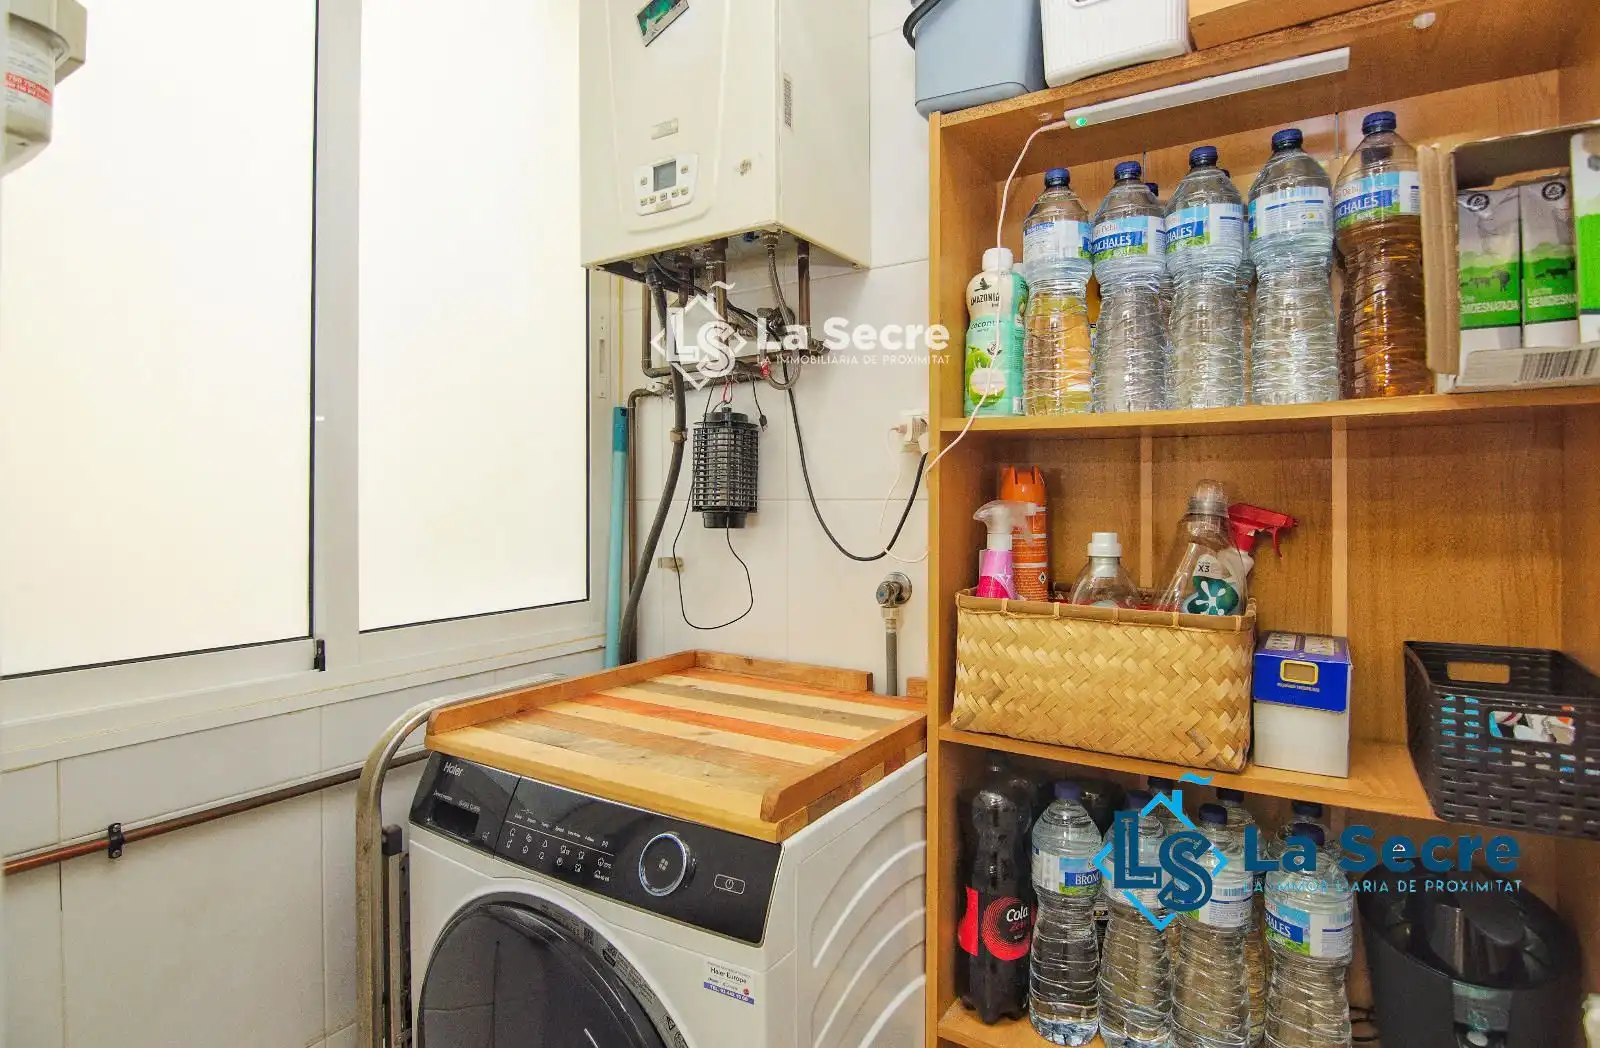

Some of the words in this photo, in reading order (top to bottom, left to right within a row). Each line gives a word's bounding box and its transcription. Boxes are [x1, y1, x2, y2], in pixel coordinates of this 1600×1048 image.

[1198, 564, 1210, 573] X3
[443, 761, 464, 777] Haier
[1006, 905, 1028, 922] Cola
